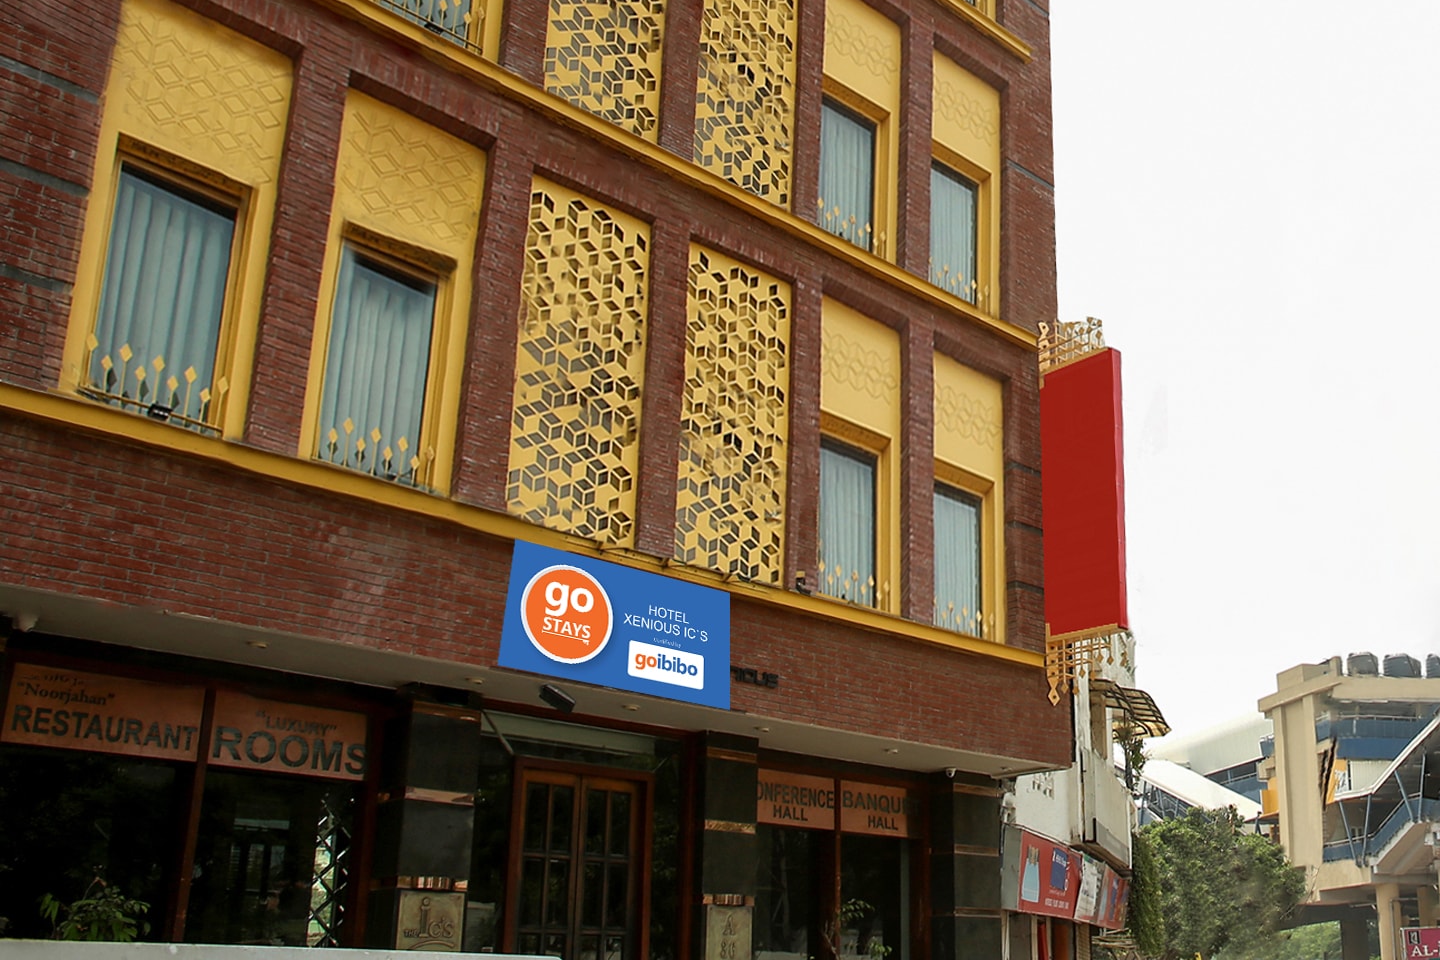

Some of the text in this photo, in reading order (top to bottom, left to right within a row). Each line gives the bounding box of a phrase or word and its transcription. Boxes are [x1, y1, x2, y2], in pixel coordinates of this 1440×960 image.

[545, 581, 594, 617] go
[623, 613, 681, 637] XENIOUS
[648, 604, 690, 625] HOTEL
[542, 616, 591, 639] STAYS
[635, 652, 698, 677] goibibo
[11, 704, 198, 751] RESTAURANT
[212, 725, 368, 775] ROOMS
[757, 781, 834, 809] ONFERENCE
[773, 804, 808, 821] HALL
[868, 815, 899, 830] HALL
